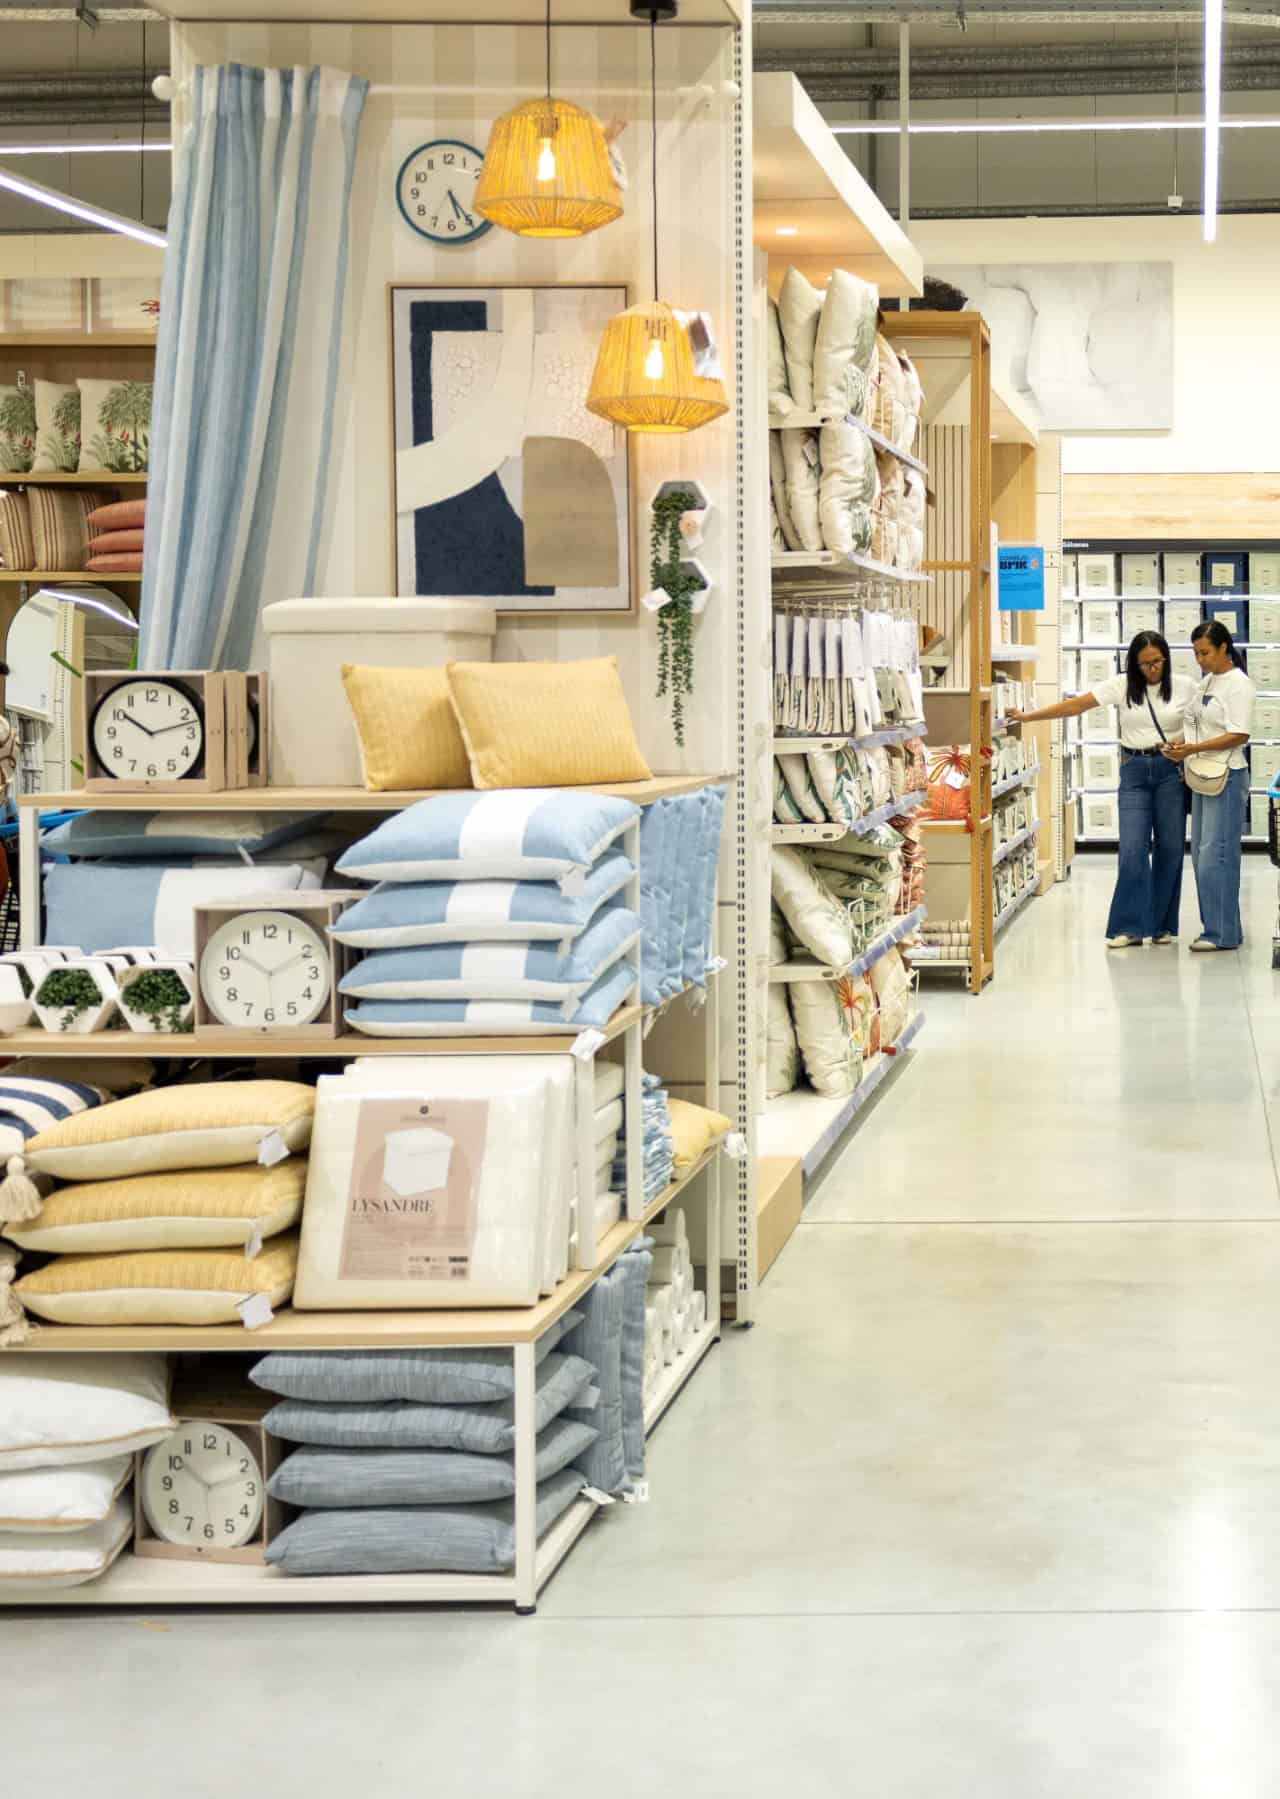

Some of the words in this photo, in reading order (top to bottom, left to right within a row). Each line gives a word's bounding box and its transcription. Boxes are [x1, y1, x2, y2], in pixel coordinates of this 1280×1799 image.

[443, 153, 455, 165] 12
[416, 172, 427, 183] 10
[411, 188, 419, 200] 9
[417, 205, 426, 216] 8
[431, 216, 438, 228] 7
[448, 220, 456, 231] 6
[128, 696, 134, 707] 11
[145, 689, 159, 702] 12
[113, 709, 126, 721] 10
[181, 708, 190, 720] 2
[107, 727, 116, 738] 9
[186, 726, 195, 740] 3
[113, 746, 123, 759] 8
[181, 745, 189, 758] 4
[128, 760, 137, 772] 7
[147, 764, 157, 777] 6
[168, 760, 177, 772] 5
[243, 930, 250, 945] 11
[263, 924, 277, 939] 12
[226, 946, 240, 960] 10
[302, 944, 312, 958] 2
[219, 967, 230, 981] 9
[309, 966, 318, 980] 3
[227, 988, 238, 1001] 8
[302, 987, 312, 1000] 4
[244, 1003, 254, 1016] 7
[264, 1008, 275, 1022] 6
[287, 1002, 297, 1015] 5
[352, 1199, 432, 1212] LYSANDRE
[184, 1440, 191, 1454] 11
[203, 1435, 217, 1449] 12
[169, 1456, 183, 1470] 10
[240, 1459, 249, 1473] 2
[163, 1476, 173, 1490] 9
[246, 1482, 256, 1497] 3
[169, 1499, 179, 1514] 8
[240, 1503, 249, 1517] 4
[184, 1517, 193, 1531] 7
[225, 1519, 235, 1533] 5
[204, 1524, 214, 1538] 6
